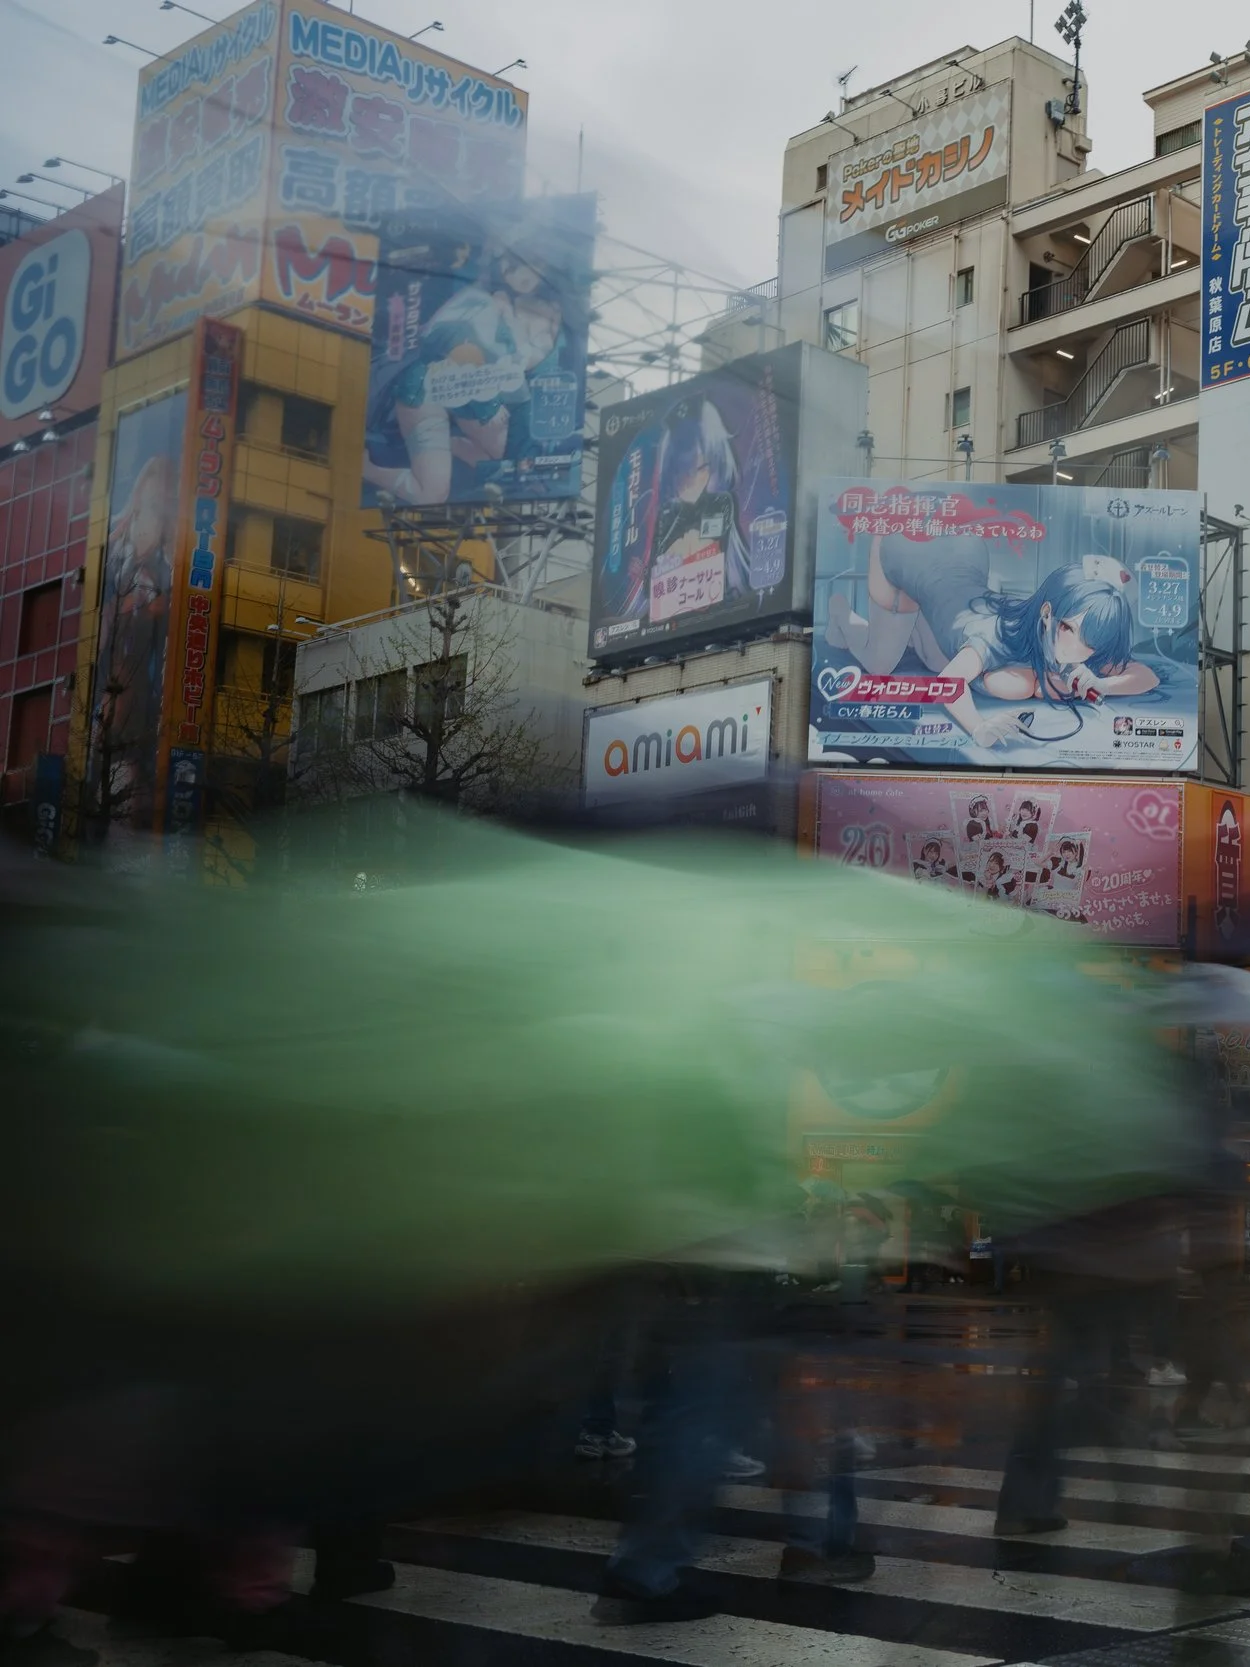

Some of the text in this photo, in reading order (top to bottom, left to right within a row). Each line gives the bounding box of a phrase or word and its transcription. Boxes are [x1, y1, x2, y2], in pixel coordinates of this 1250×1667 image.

[290, 12, 525, 128] MEDIAリサイクル
[1211, 126, 1224, 253] トレーディングカードゲーム
[11, 253, 59, 332] Gi
[1208, 275, 1224, 355] 秋葉原店
[4, 316, 77, 404] GO
[842, 493, 960, 517] 同志指揮官
[1133, 503, 1189, 518] アズールレーン
[852, 516, 1044, 539] 検査の準備はできているわ
[1148, 581, 1181, 597] 3.27
[823, 675, 850, 692] New
[857, 680, 958, 697] ヴォロシーロフ
[838, 704, 912, 719] CV:春花らん
[604, 714, 748, 777] amiami
[1122, 741, 1155, 749] YOSTAR
